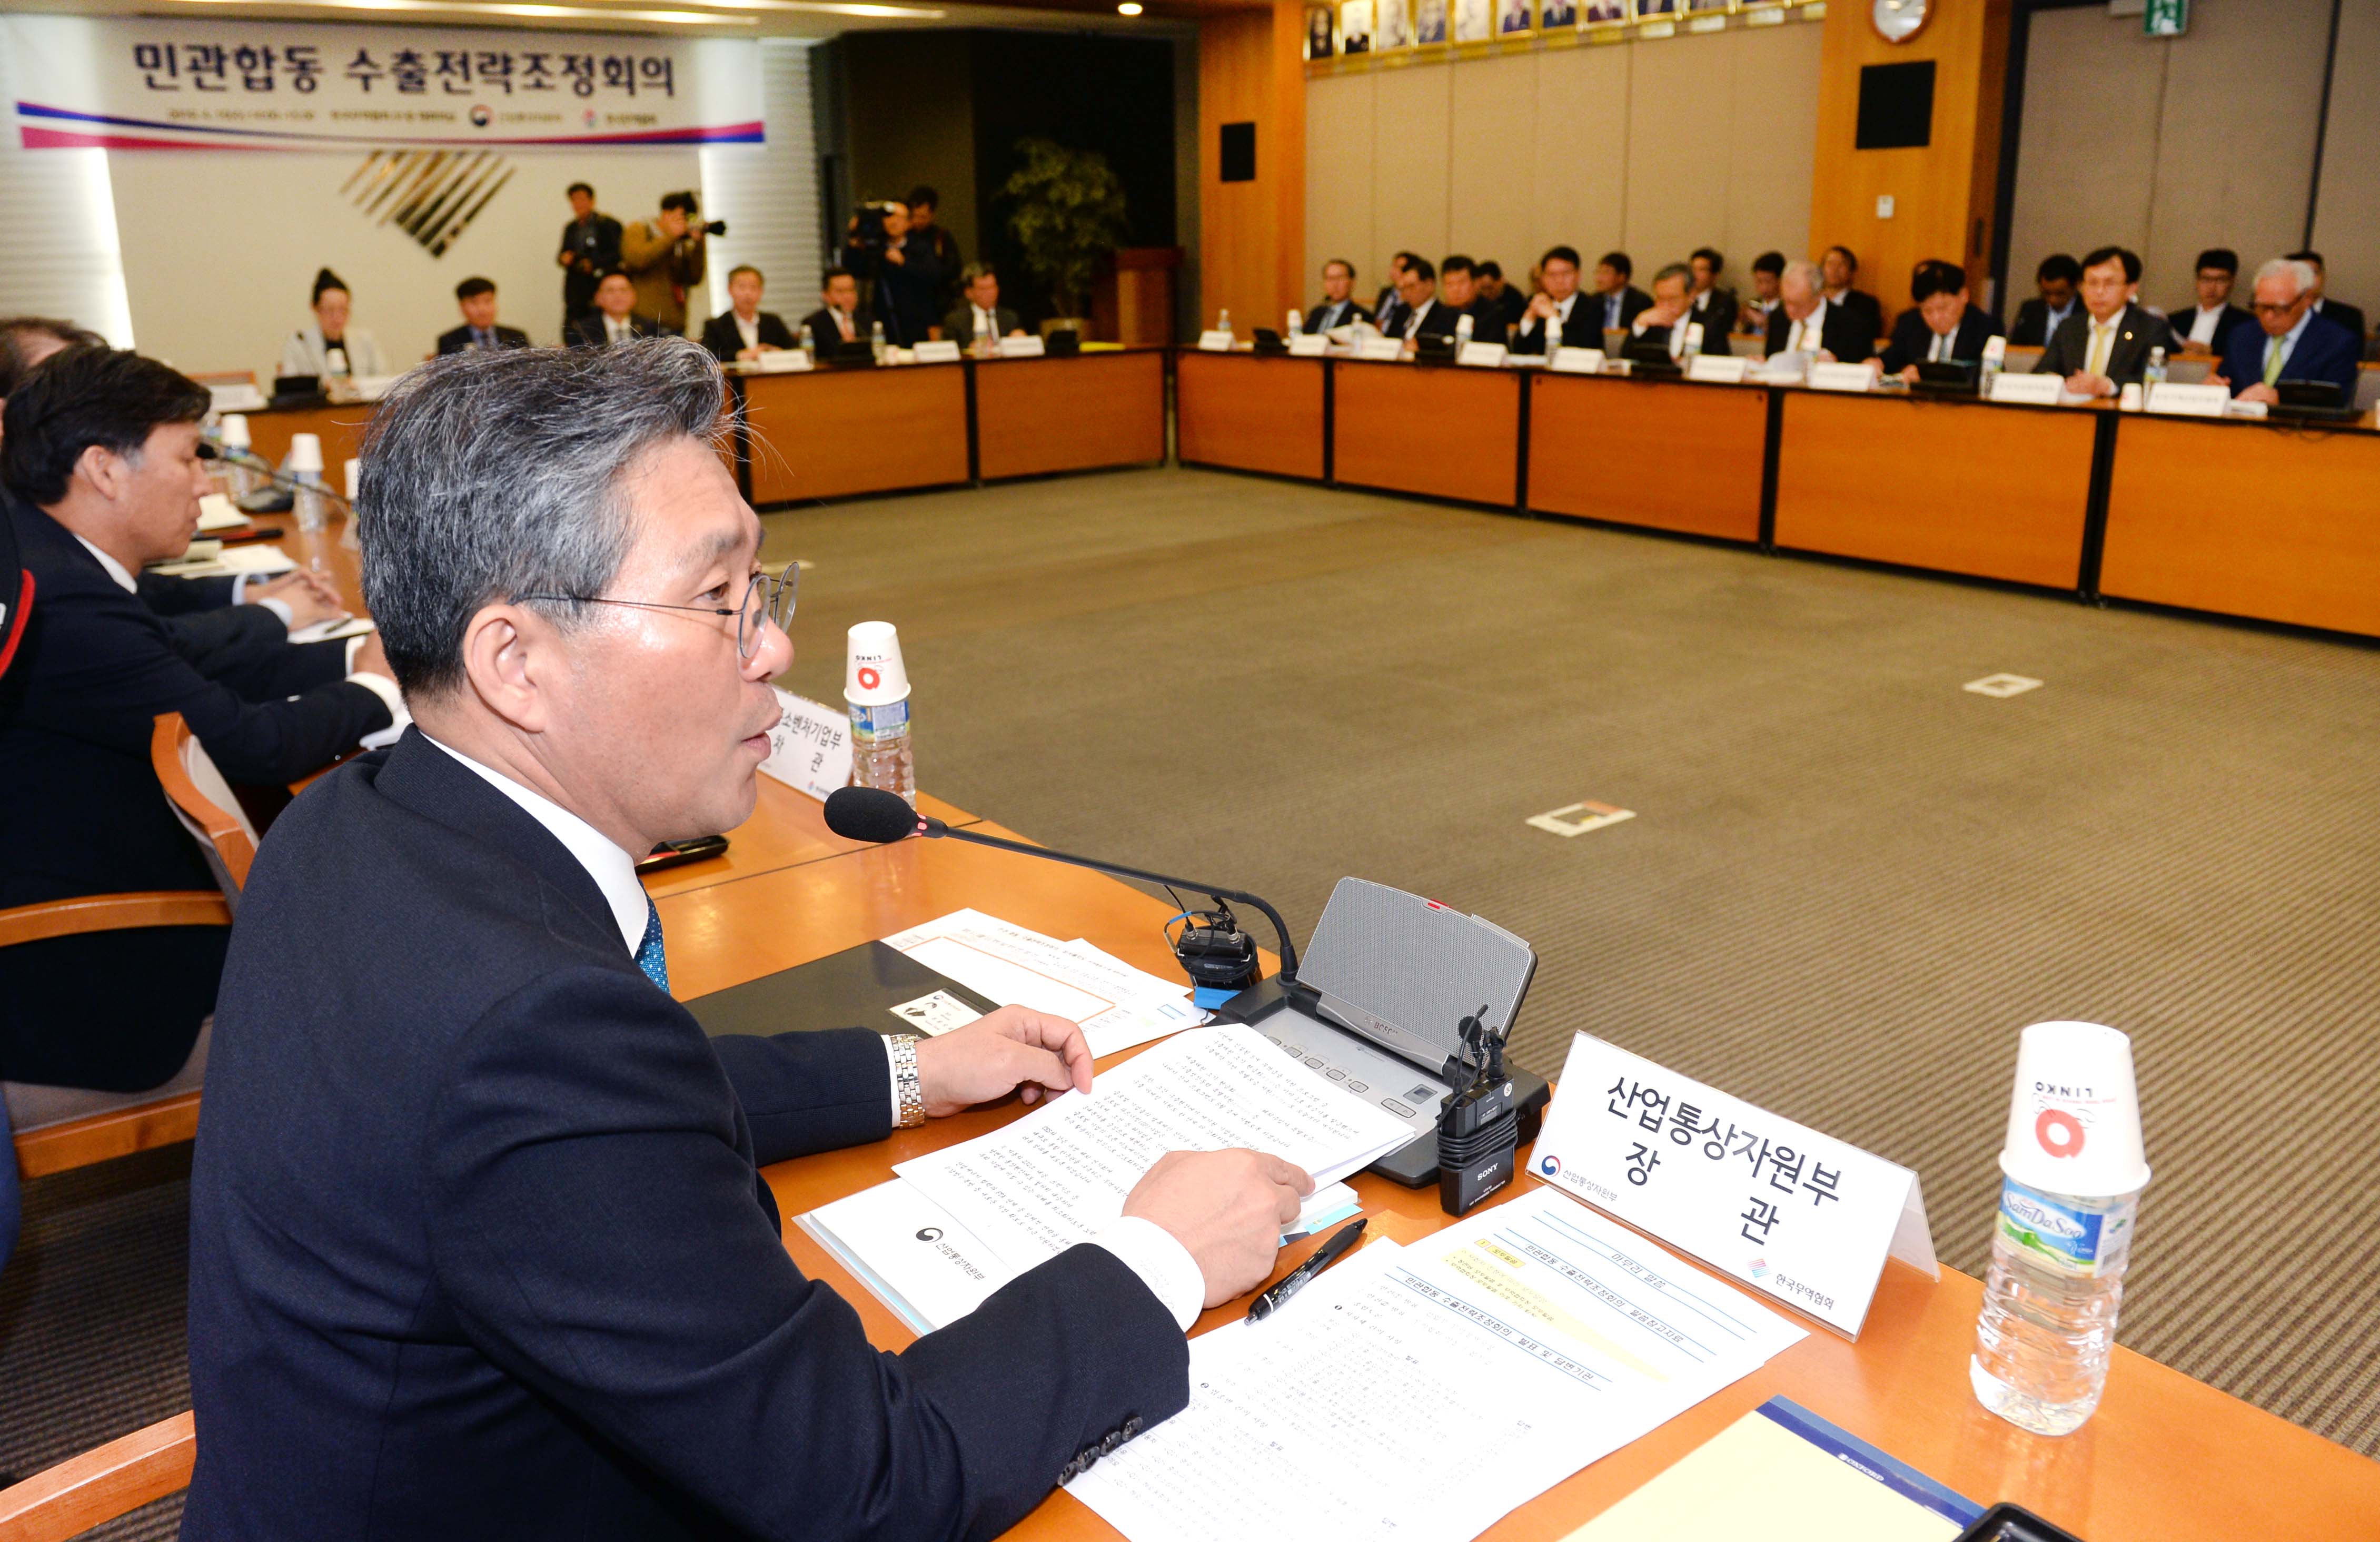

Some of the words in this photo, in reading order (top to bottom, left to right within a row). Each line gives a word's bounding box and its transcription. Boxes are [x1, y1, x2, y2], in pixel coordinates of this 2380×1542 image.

[134, 43, 325, 93] 민관합동
[344, 48, 676, 97] 수출전략조정회의
[782, 712, 842, 750] 소벤처기업부
[2036, 1082, 2093, 1098] LINKO
[1607, 1076, 1841, 1207] 산업통상자원부
[1477, 1163, 1498, 1181] SONY
[1563, 1170, 1618, 1201] 산업통상자원부
[1626, 1142, 1661, 1186] 장
[1740, 1197, 1780, 1246] 관
[936, 1243, 986, 1280] 산업통상자원부
[1611, 1254, 1643, 1274] 마무리
[1644, 1274, 1666, 1288] 말씀
[1776, 1273, 1834, 1310] 한국무역협회
[1554, 1358, 1594, 1381] 답변기관
